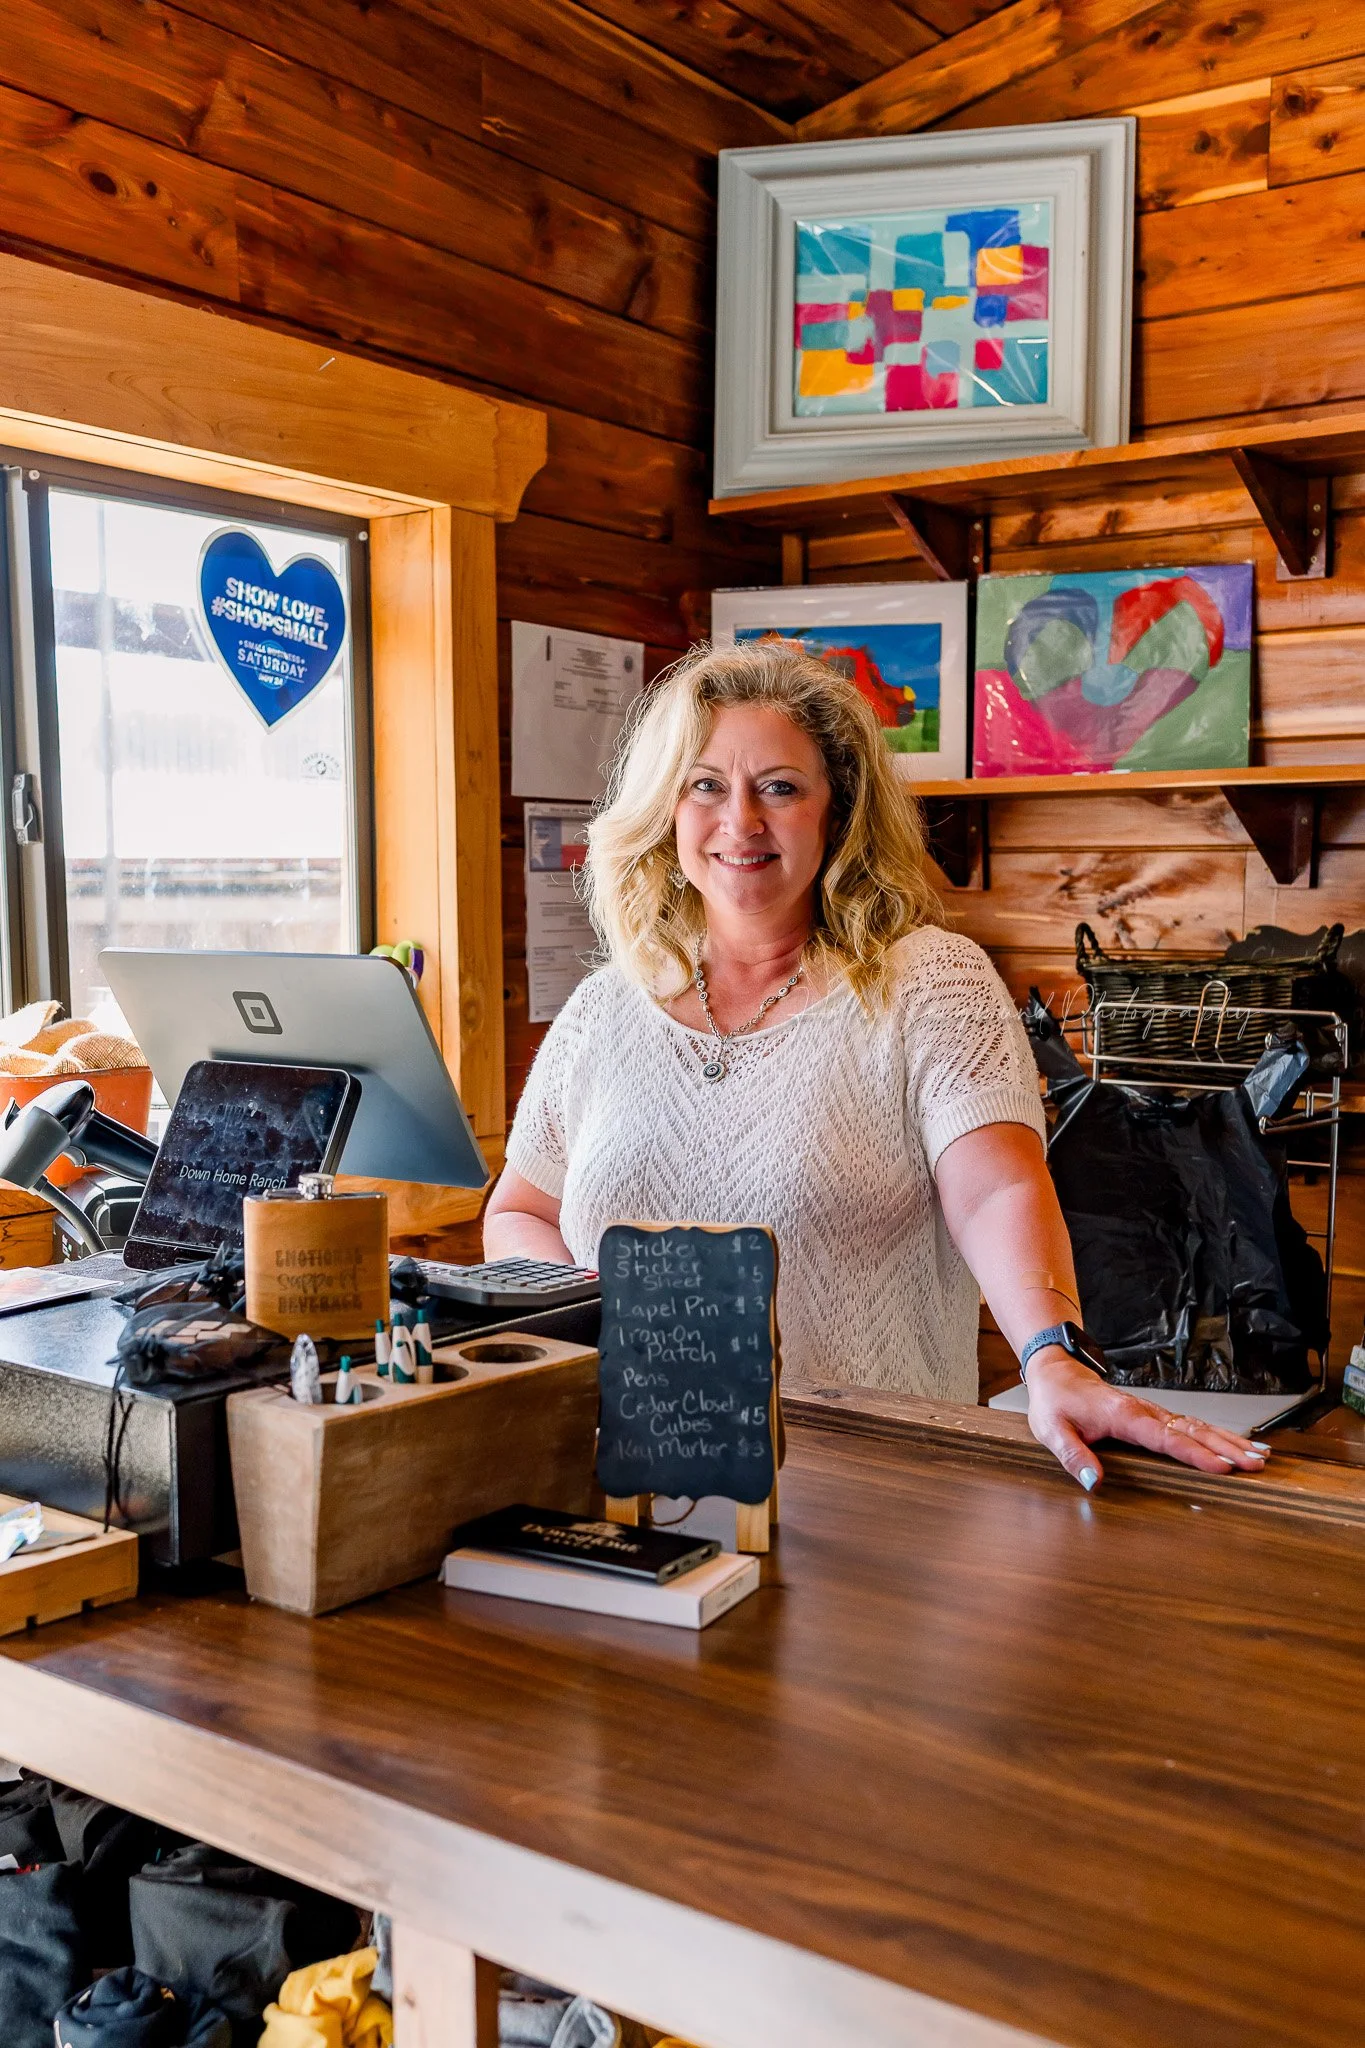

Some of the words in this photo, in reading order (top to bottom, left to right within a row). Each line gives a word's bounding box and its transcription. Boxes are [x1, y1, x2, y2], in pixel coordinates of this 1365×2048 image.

[225, 577, 280, 611] SHOW
[282, 596, 330, 632] LOVE,
[211, 596, 329, 651] #SHOPSMALL
[237, 648, 306, 678] SATURDAY
[180, 1165, 211, 1181] Down
[213, 1169, 247, 1185] Home
[249, 1173, 287, 1189] Ranch
[616, 1296, 676, 1323] Lapel
[685, 1296, 720, 1317] Pin
[647, 1341, 717, 1364] Patch
[623, 1367, 670, 1388] Pens
[620, 1392, 680, 1420] Cedar
[650, 1412, 713, 1437] Cubes
